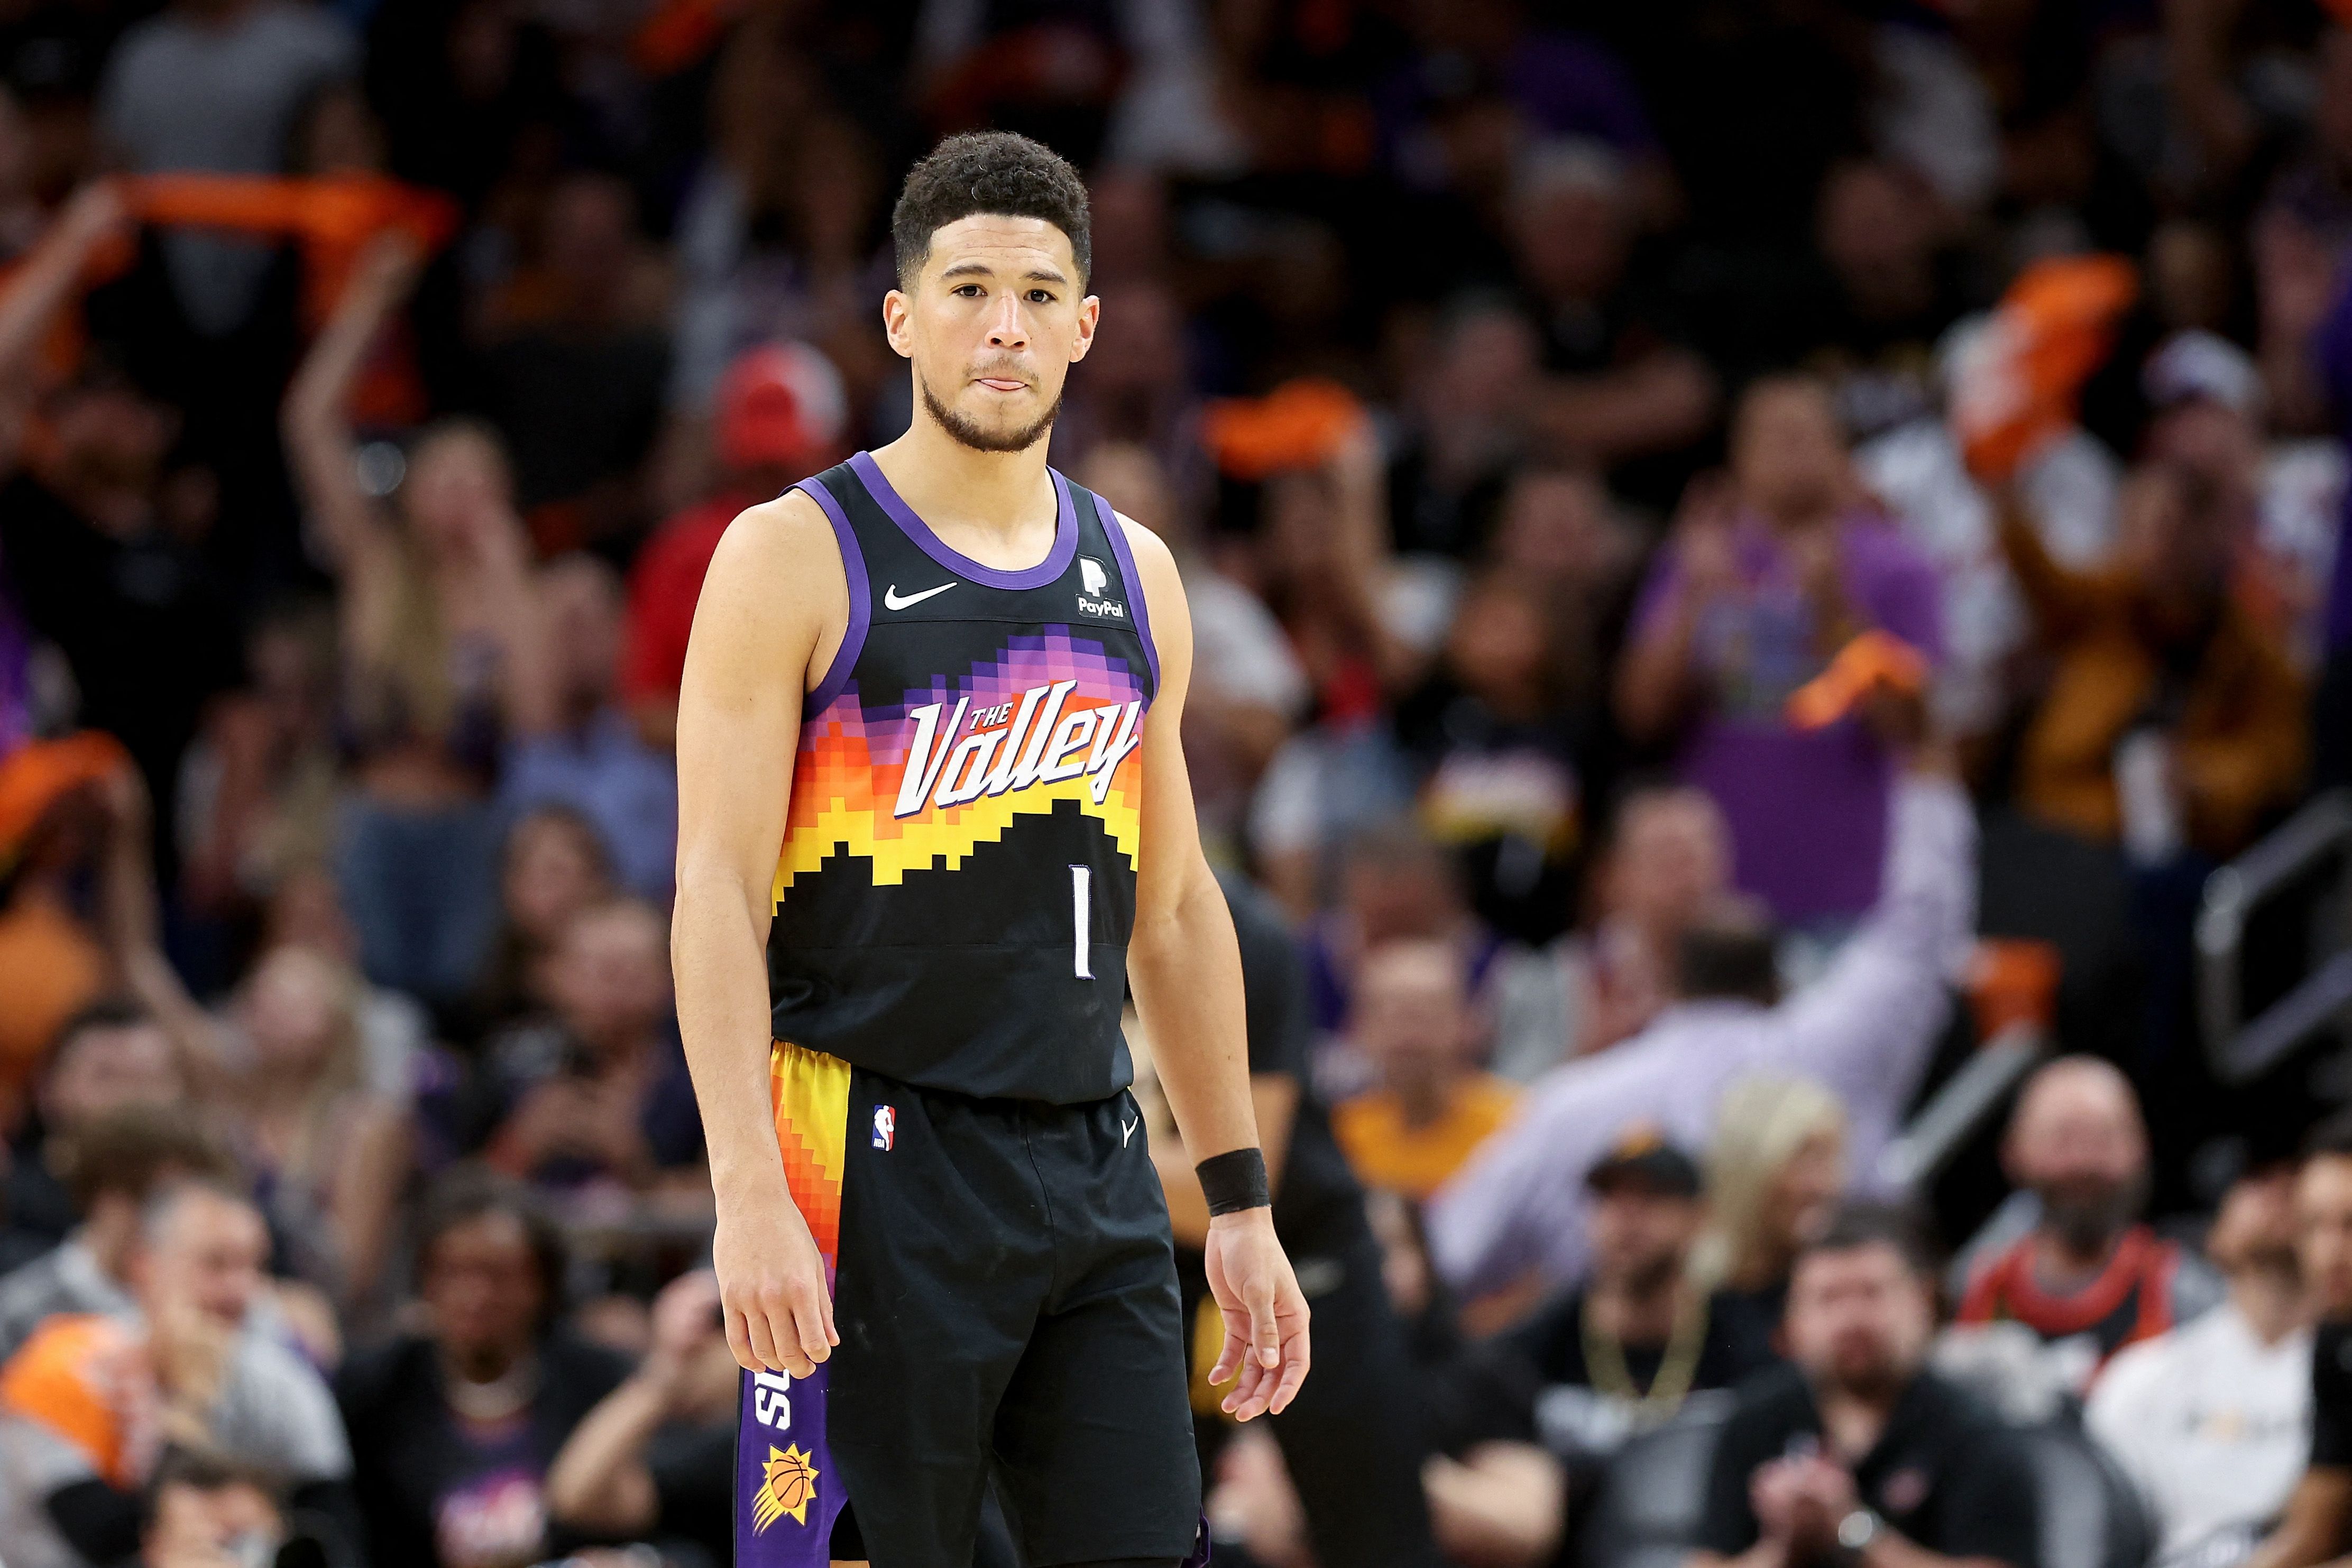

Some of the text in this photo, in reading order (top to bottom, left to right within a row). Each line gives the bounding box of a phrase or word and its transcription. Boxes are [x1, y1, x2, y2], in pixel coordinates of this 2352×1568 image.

[1078, 597, 1124, 617] PayPal
[969, 702, 1014, 730] THE
[893, 679, 1141, 819] Valley
[1068, 863, 1096, 980] 1
[873, 1138, 885, 1148] NBA
